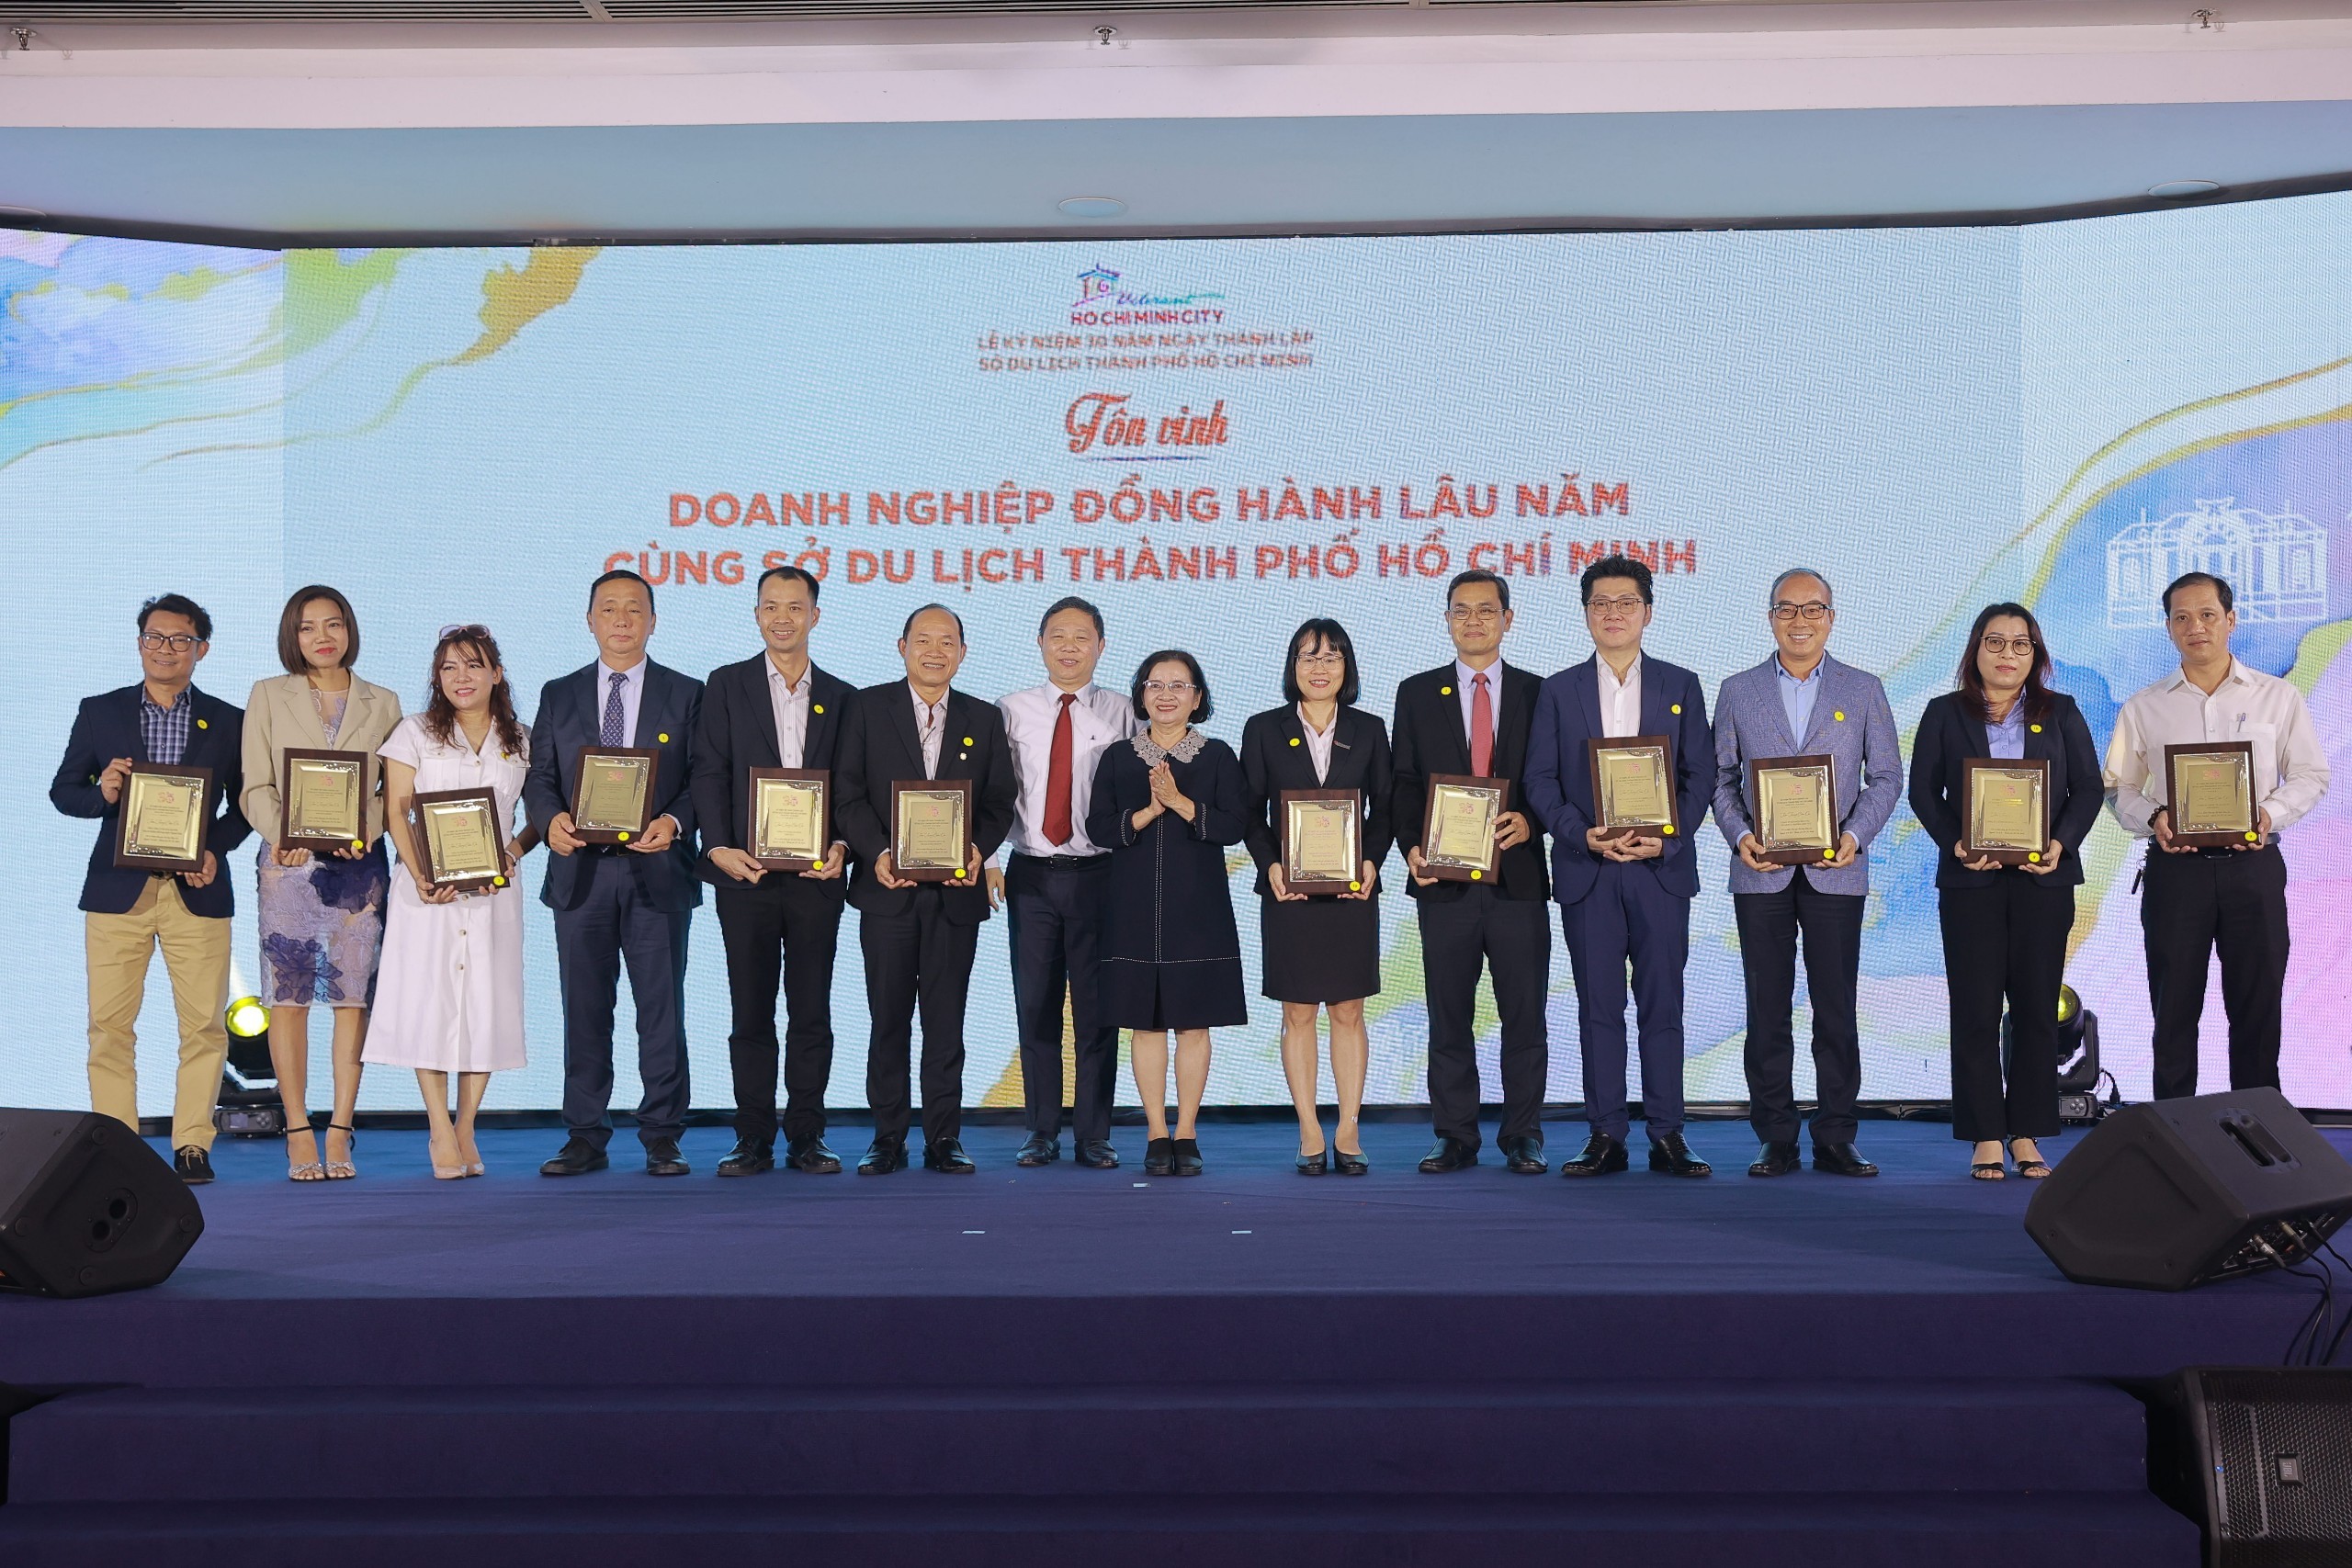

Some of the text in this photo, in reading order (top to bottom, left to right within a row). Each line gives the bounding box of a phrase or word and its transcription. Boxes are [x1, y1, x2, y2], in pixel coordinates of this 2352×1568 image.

[1134, 310, 1179, 324] MINH
[1182, 309, 1224, 324] CITY
[1009, 357, 1032, 370] DU
[1261, 353, 1313, 367] MINH
[1065, 392, 1229, 455] Tôn vinh
[670, 473, 1629, 534] DOANH NGHIỆP ĐỒNG HÀNH LÂU NĂM
[604, 540, 744, 586] CÙNG
[847, 550, 914, 584] DU
[933, 549, 1044, 592] LỊCH
[1061, 536, 1238, 582] THÀNH
[1254, 528, 1361, 579] PHỐ
[1378, 527, 1450, 578] HỒ
[1467, 531, 1551, 575] CHÍ
[2282, 1462, 2293, 1477] JBL
